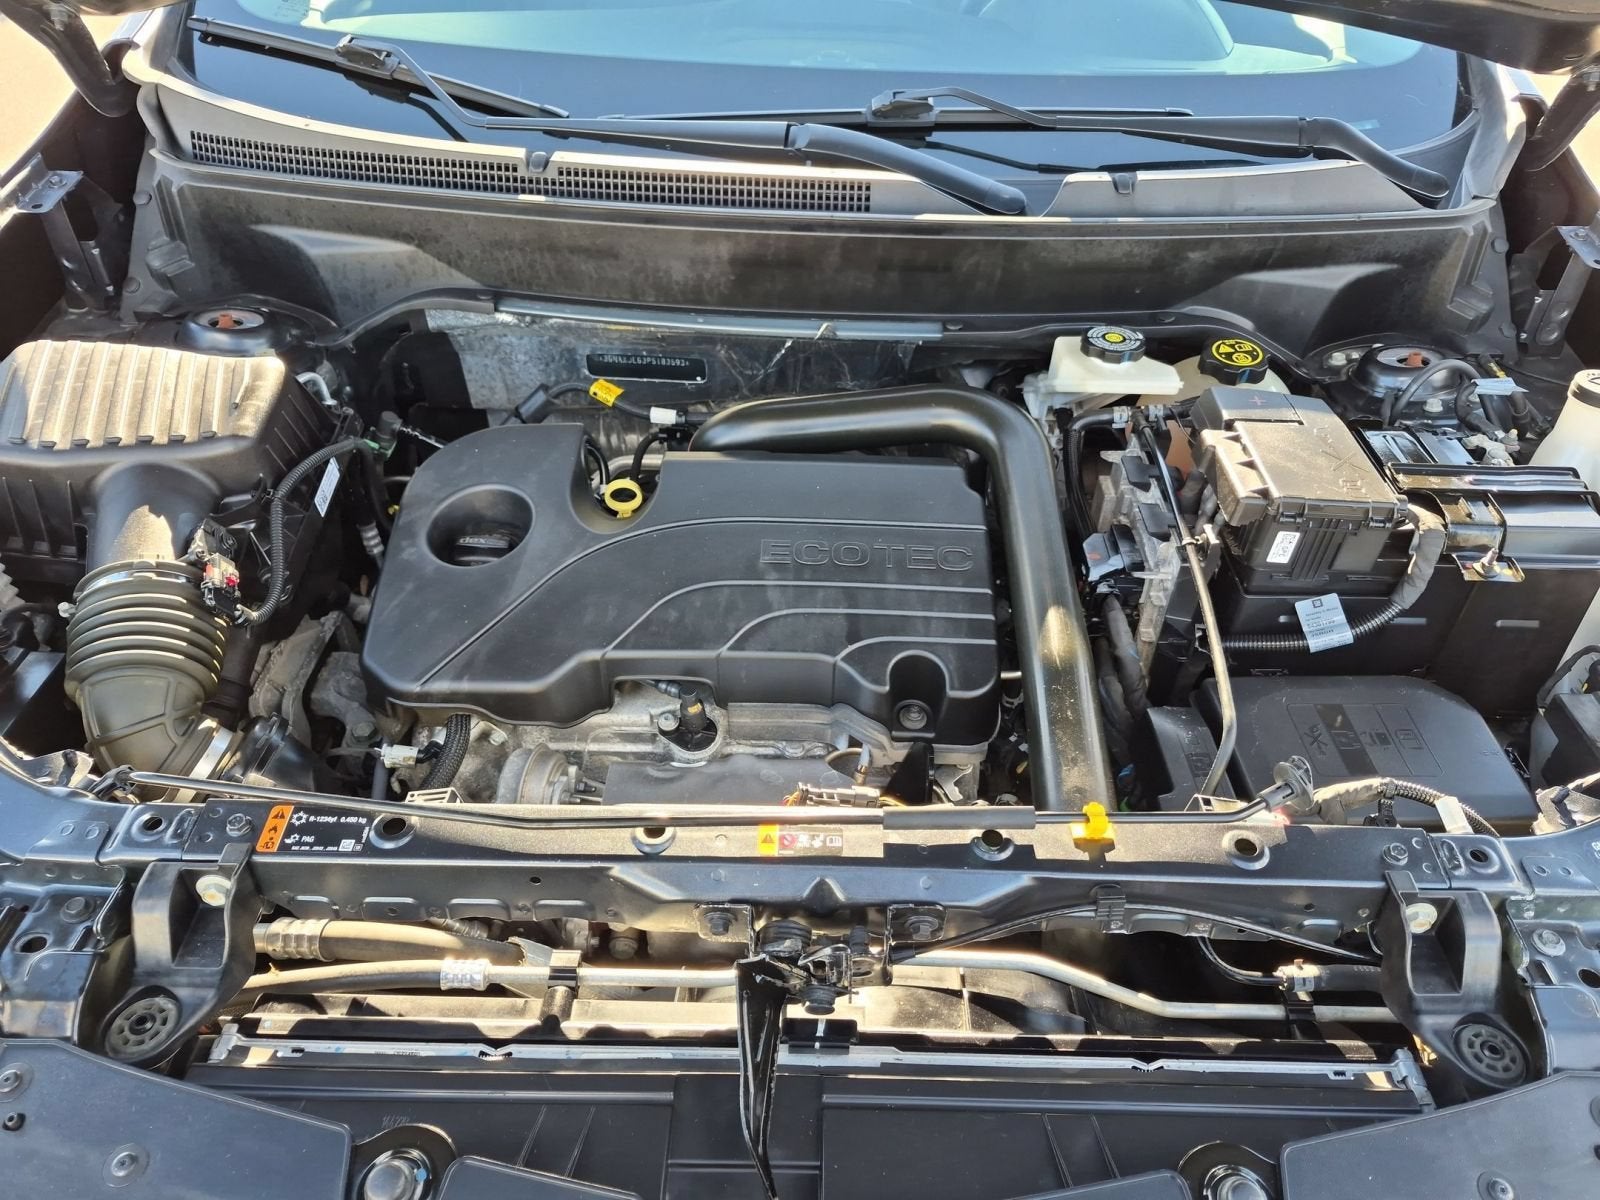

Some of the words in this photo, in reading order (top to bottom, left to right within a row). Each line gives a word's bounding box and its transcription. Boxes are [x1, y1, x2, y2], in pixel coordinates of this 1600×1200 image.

[759, 538, 974, 571] ECOTEC
[308, 815, 338, 823] R-1234yf
[358, 816, 367, 824] kg
